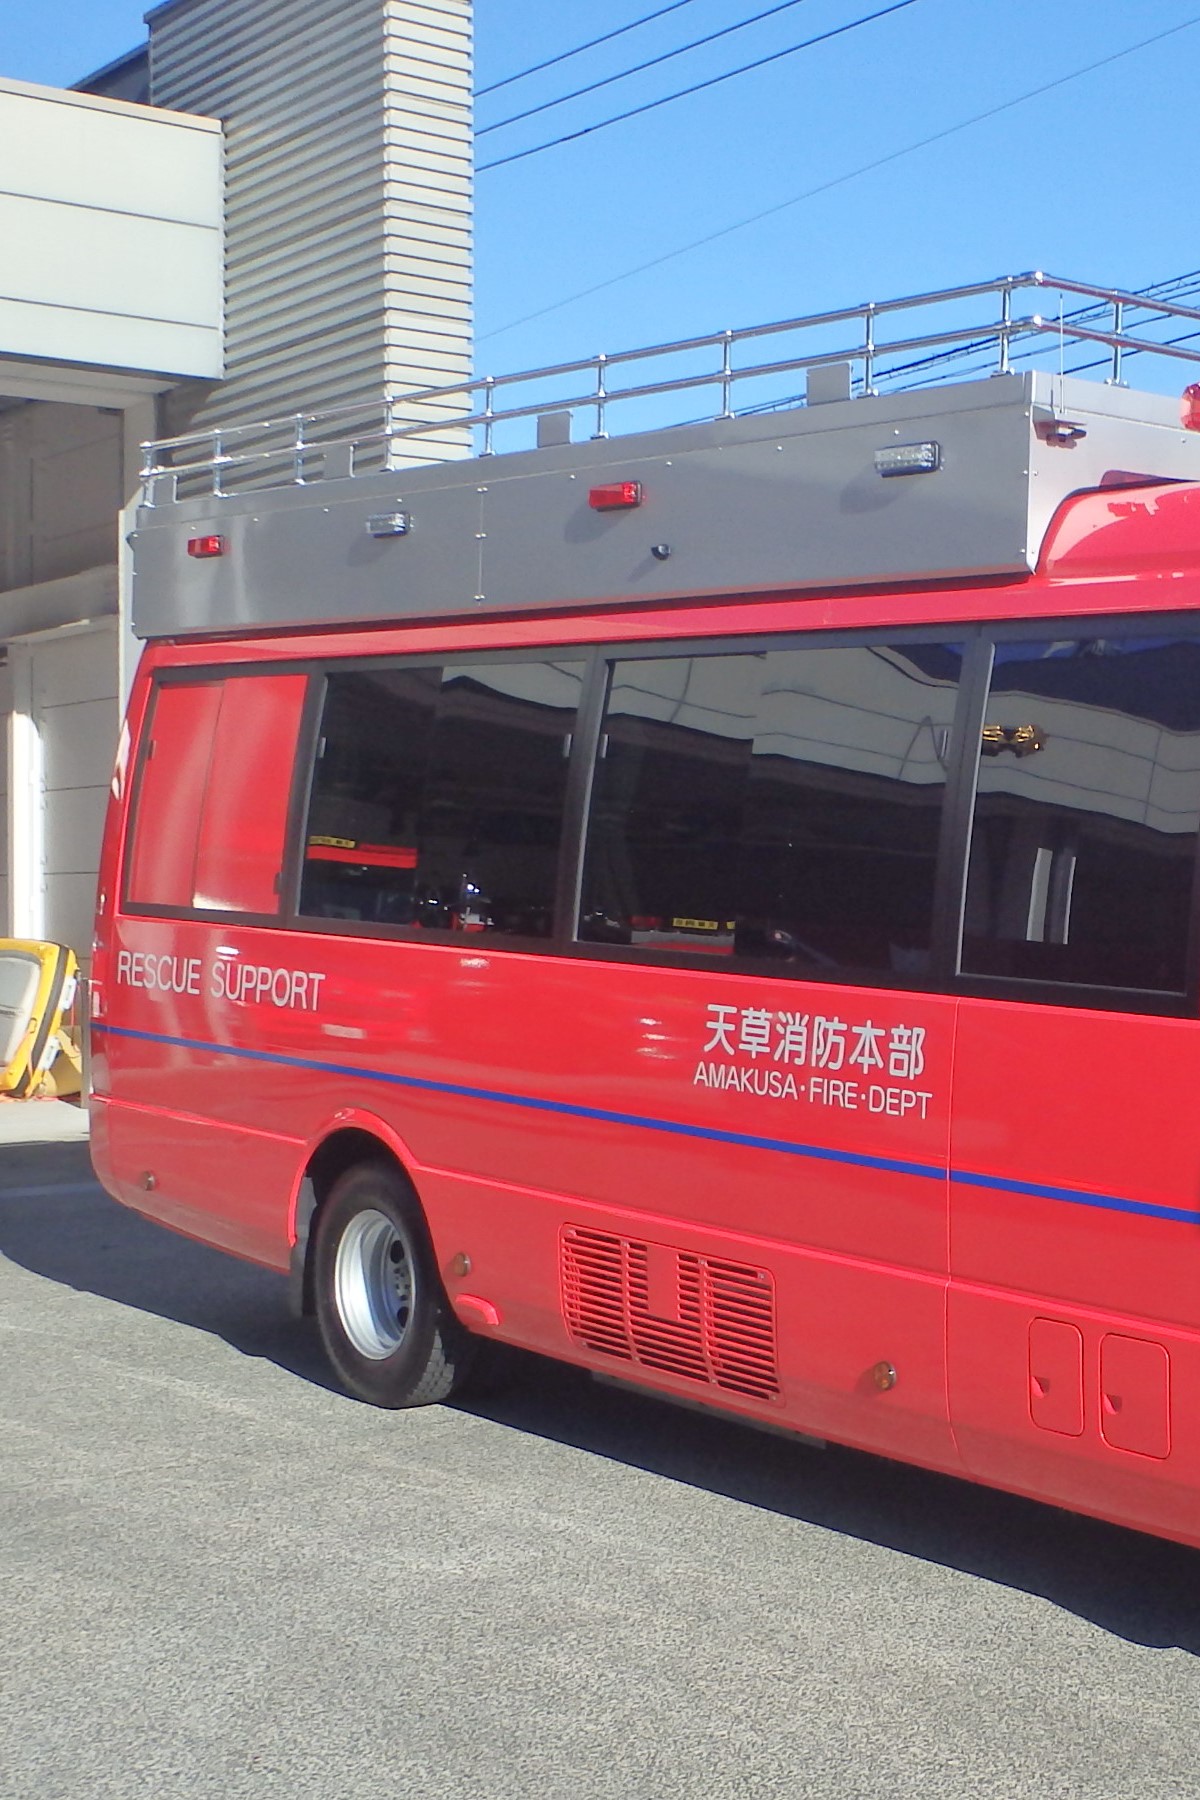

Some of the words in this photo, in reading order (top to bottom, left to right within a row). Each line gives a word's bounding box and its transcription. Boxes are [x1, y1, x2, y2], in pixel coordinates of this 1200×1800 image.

[117, 950, 202, 995] RESCUE
[210, 961, 326, 1011] SUPPORT
[703, 1003, 926, 1080] 天草消防本部
